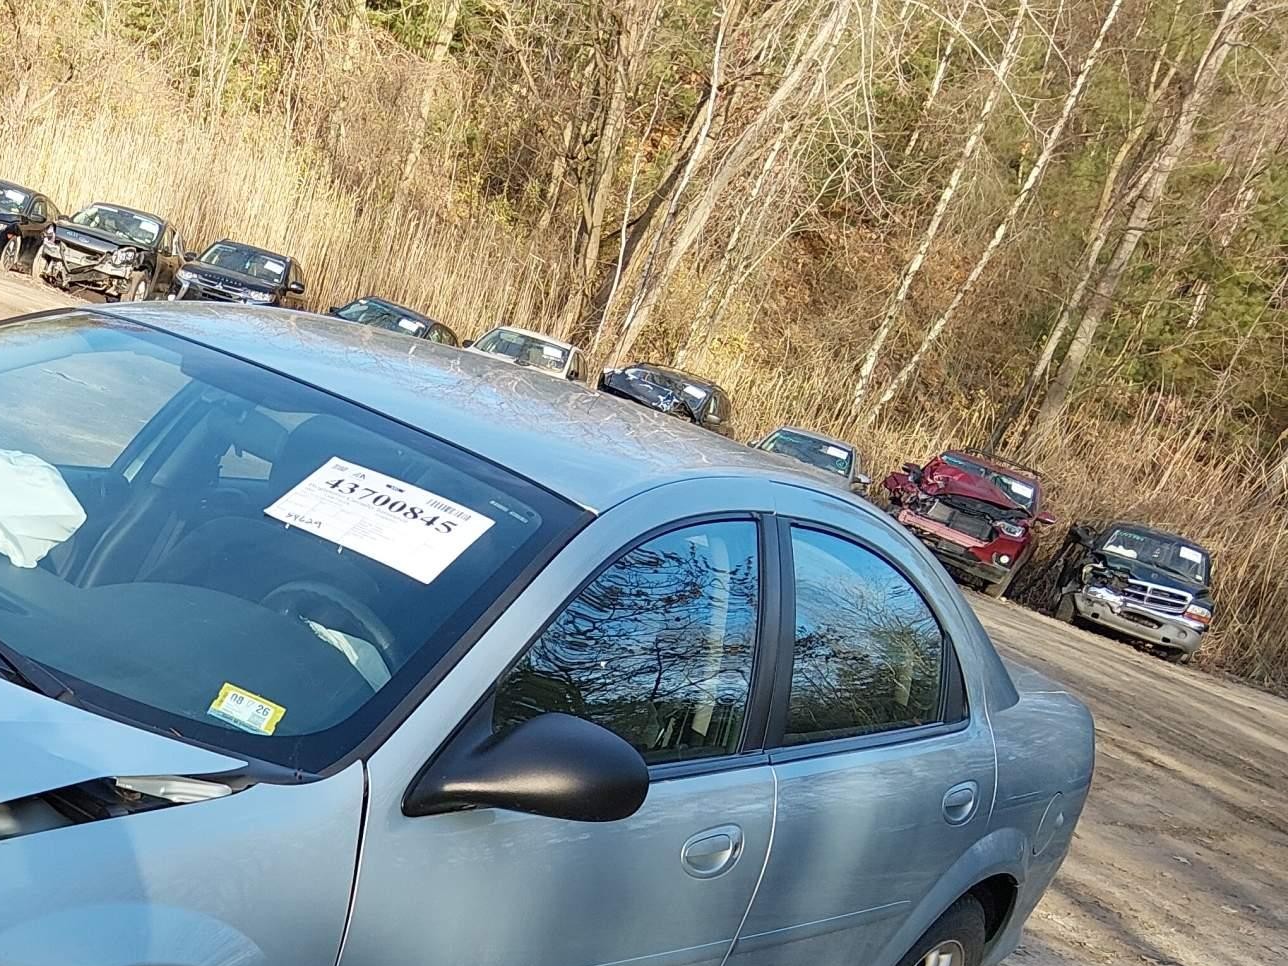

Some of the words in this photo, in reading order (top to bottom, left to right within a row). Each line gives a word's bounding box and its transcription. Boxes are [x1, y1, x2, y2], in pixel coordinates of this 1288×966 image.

[325, 478, 458, 534] 43700845
[230, 693, 245, 705] 08
[255, 704, 271, 717] 26
